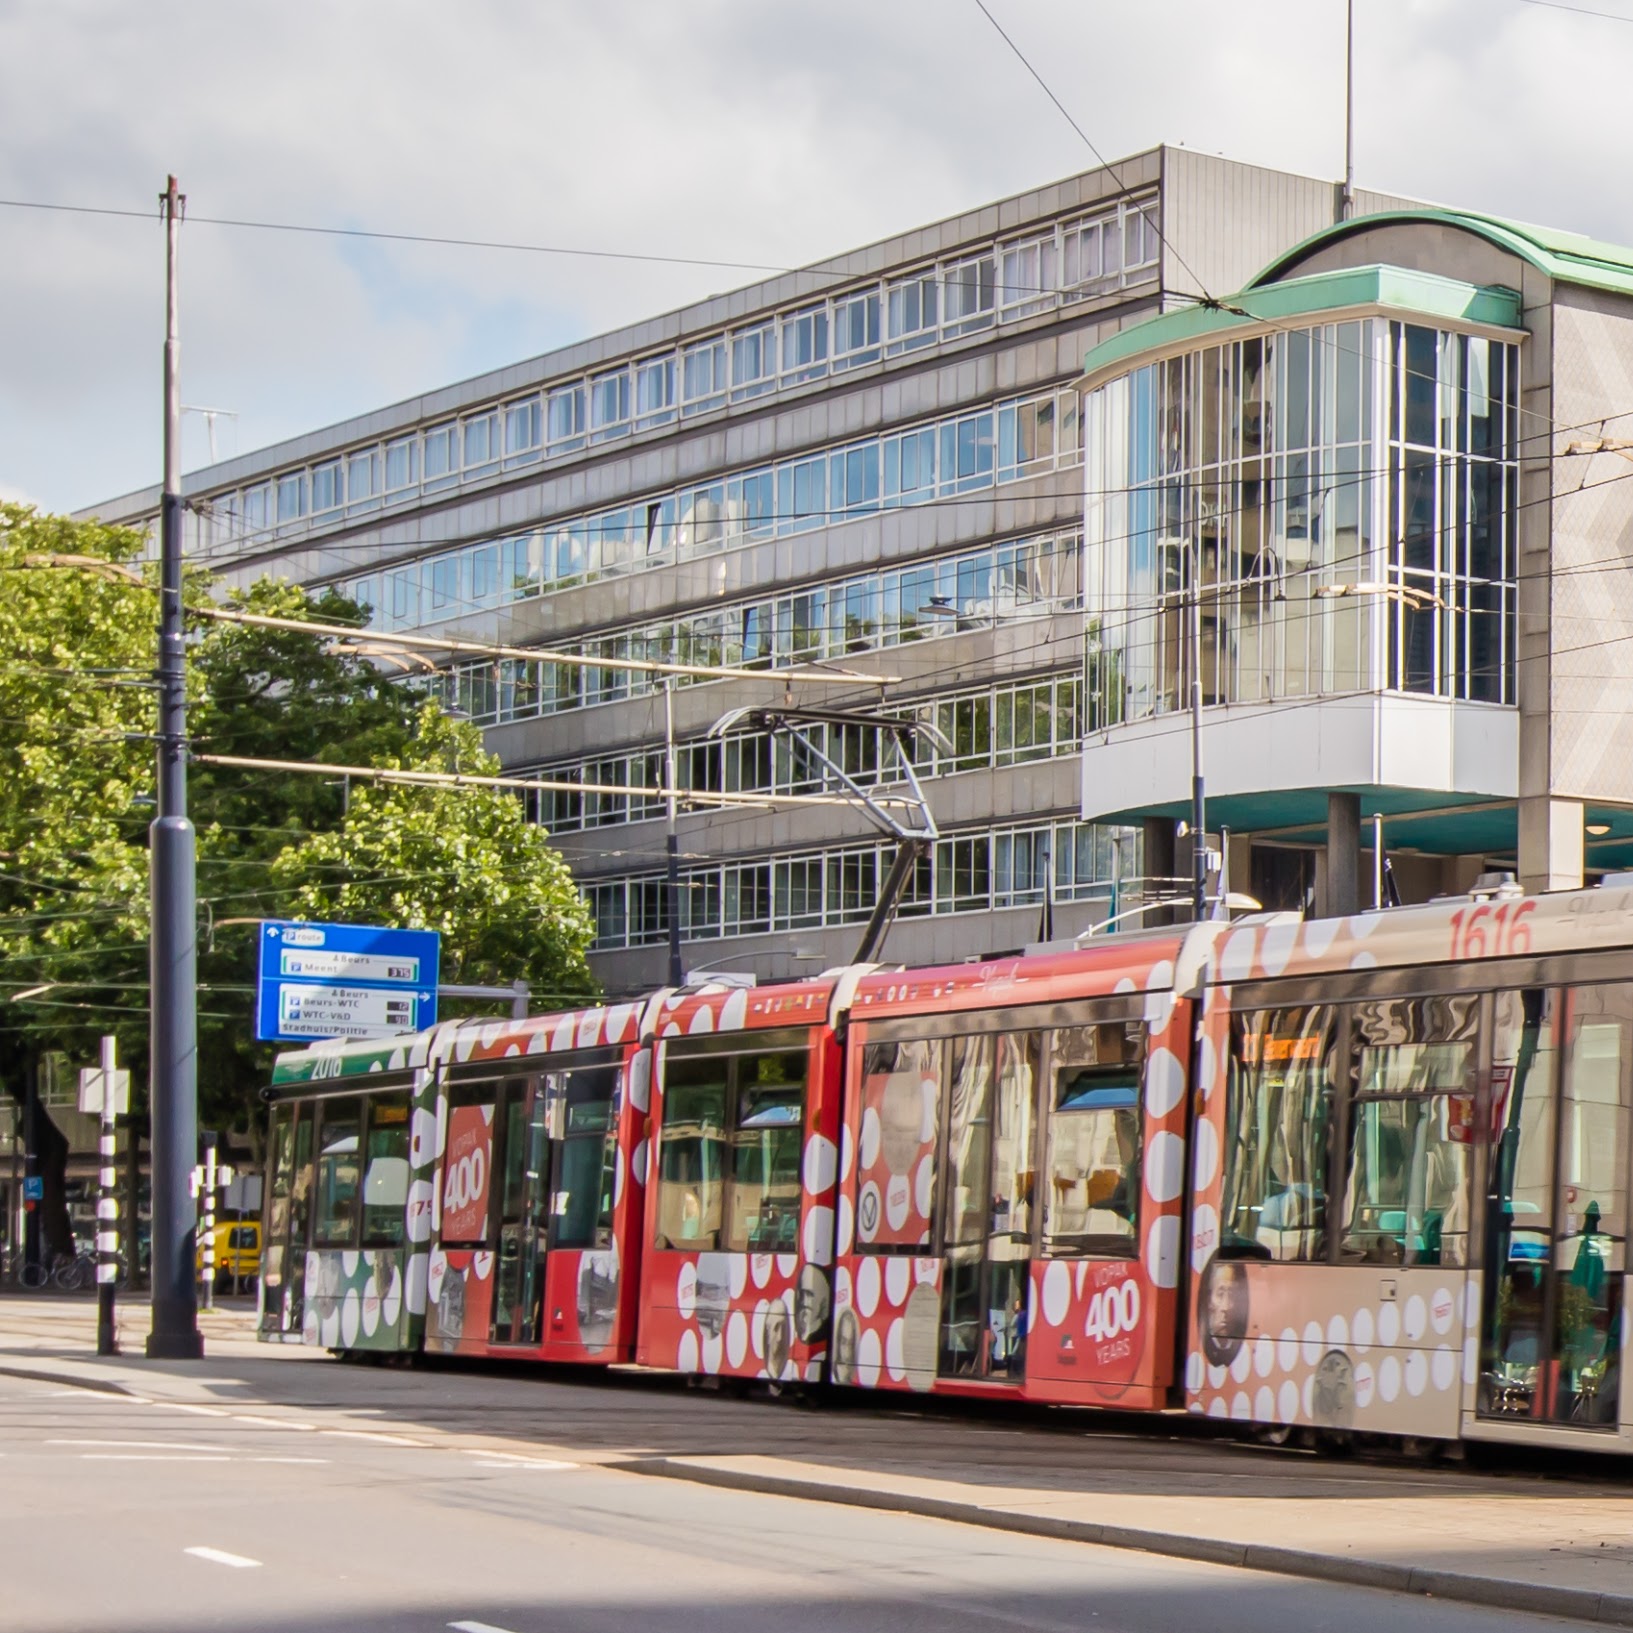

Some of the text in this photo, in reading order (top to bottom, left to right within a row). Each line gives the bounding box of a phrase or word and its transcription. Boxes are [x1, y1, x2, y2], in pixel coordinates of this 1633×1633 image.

[1450, 900, 1537, 960] 1616
[340, 990, 369, 999] Beurs
[444, 1148, 484, 1214] 400
[1085, 1279, 1140, 1342] 400
